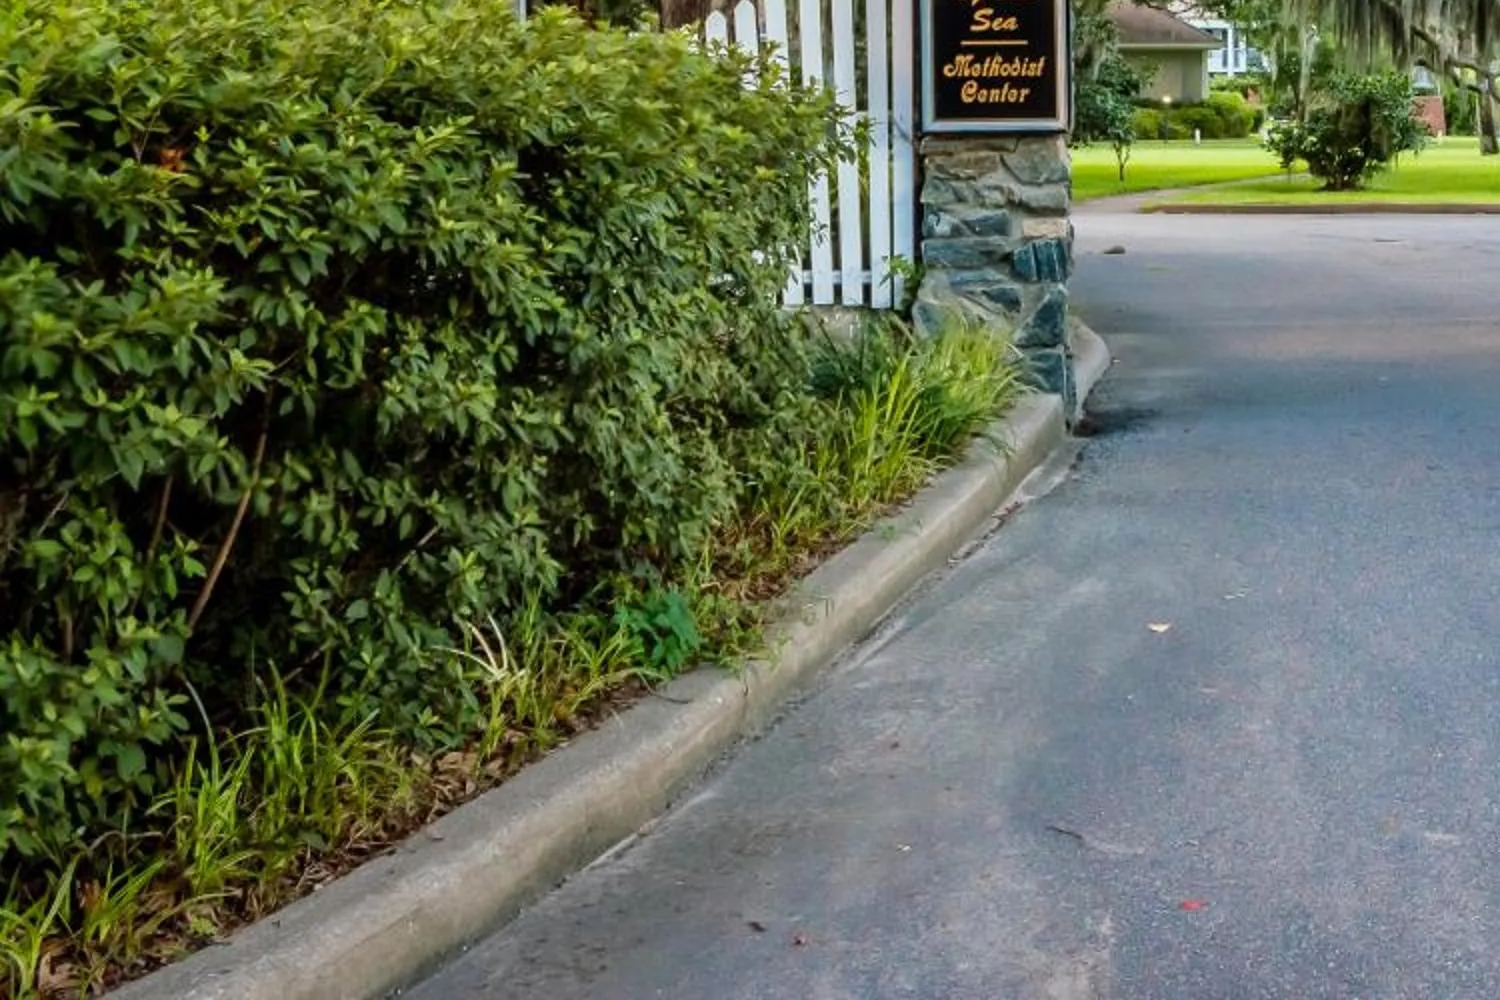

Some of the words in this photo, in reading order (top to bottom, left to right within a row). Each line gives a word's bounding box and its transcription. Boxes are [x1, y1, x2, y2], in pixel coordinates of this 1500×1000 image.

[969, 8, 1019, 31] Sea
[943, 53, 1046, 78] Methodist
[960, 79, 1030, 104] Center
